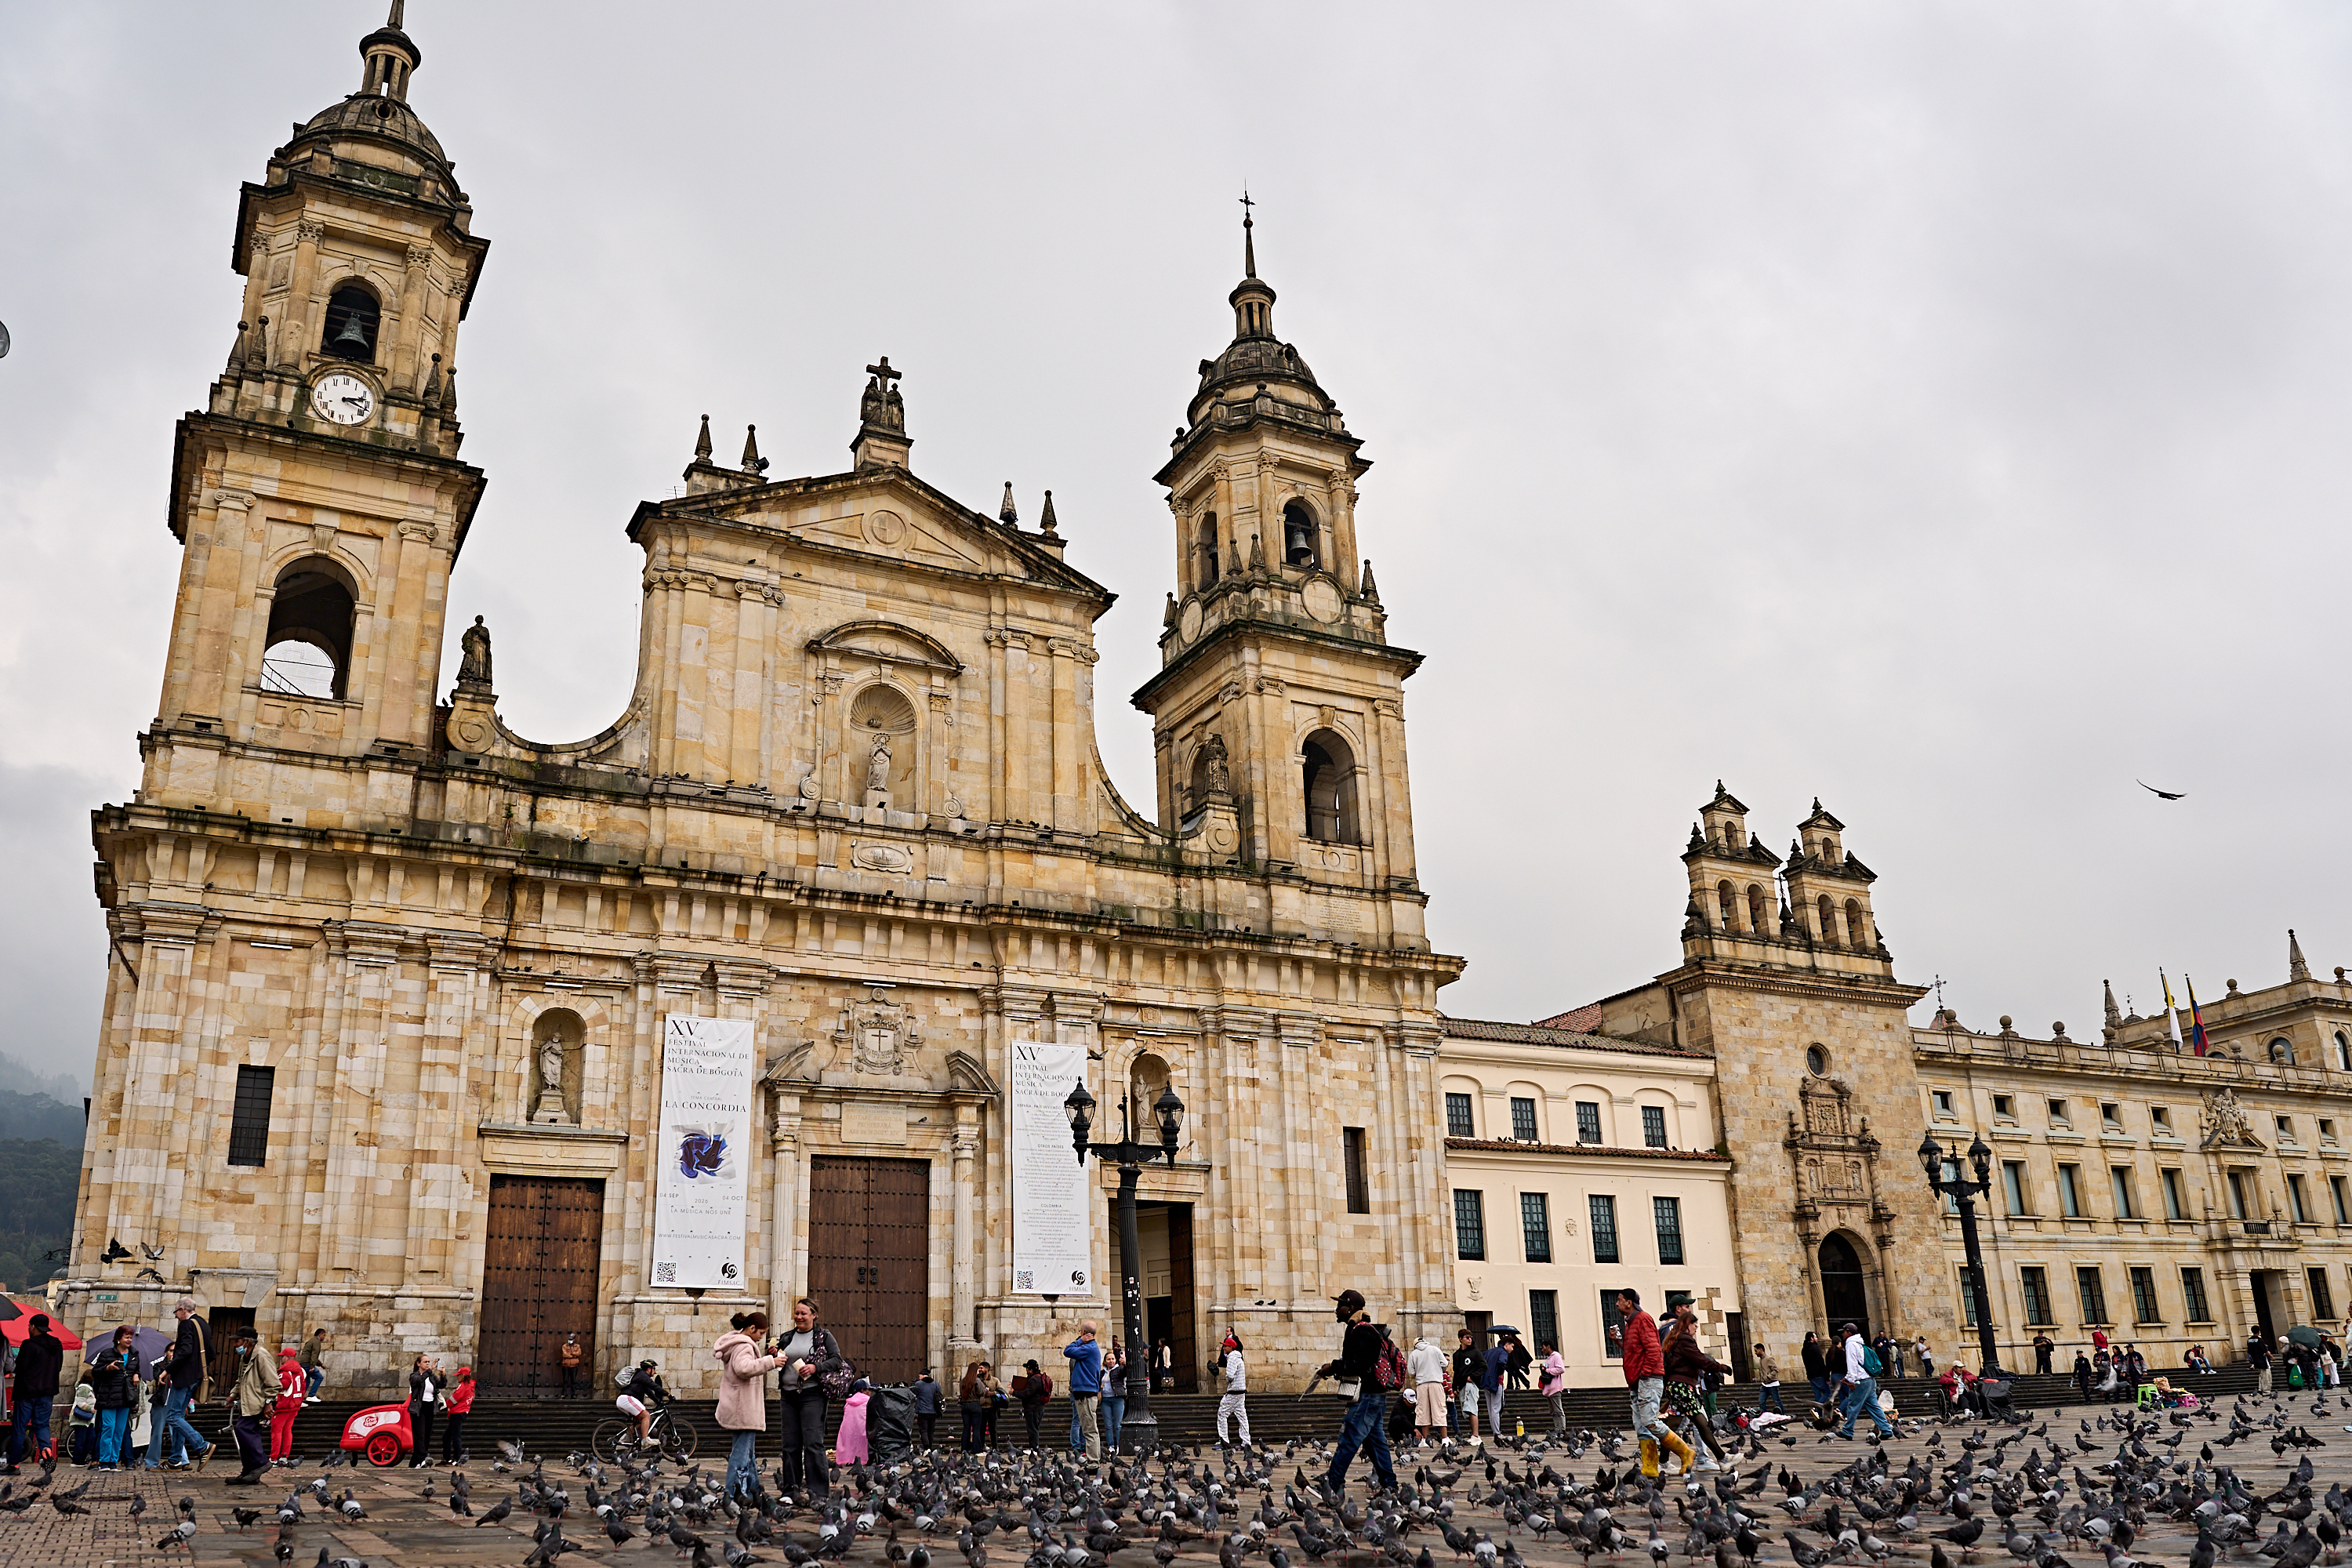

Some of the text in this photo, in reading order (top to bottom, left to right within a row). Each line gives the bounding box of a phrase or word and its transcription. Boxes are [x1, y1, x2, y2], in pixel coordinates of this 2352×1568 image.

[670, 1020, 699, 1036] XV
[669, 1039, 707, 1047] FESTIVAL
[668, 1048, 737, 1058] INTERNACIONAL
[1016, 1046, 1040, 1061] XV
[668, 1056, 700, 1065] MÚSICA
[1015, 1073, 1073, 1081] INTERNACIONAL
[682, 1102, 746, 1112] CONCORDIA
